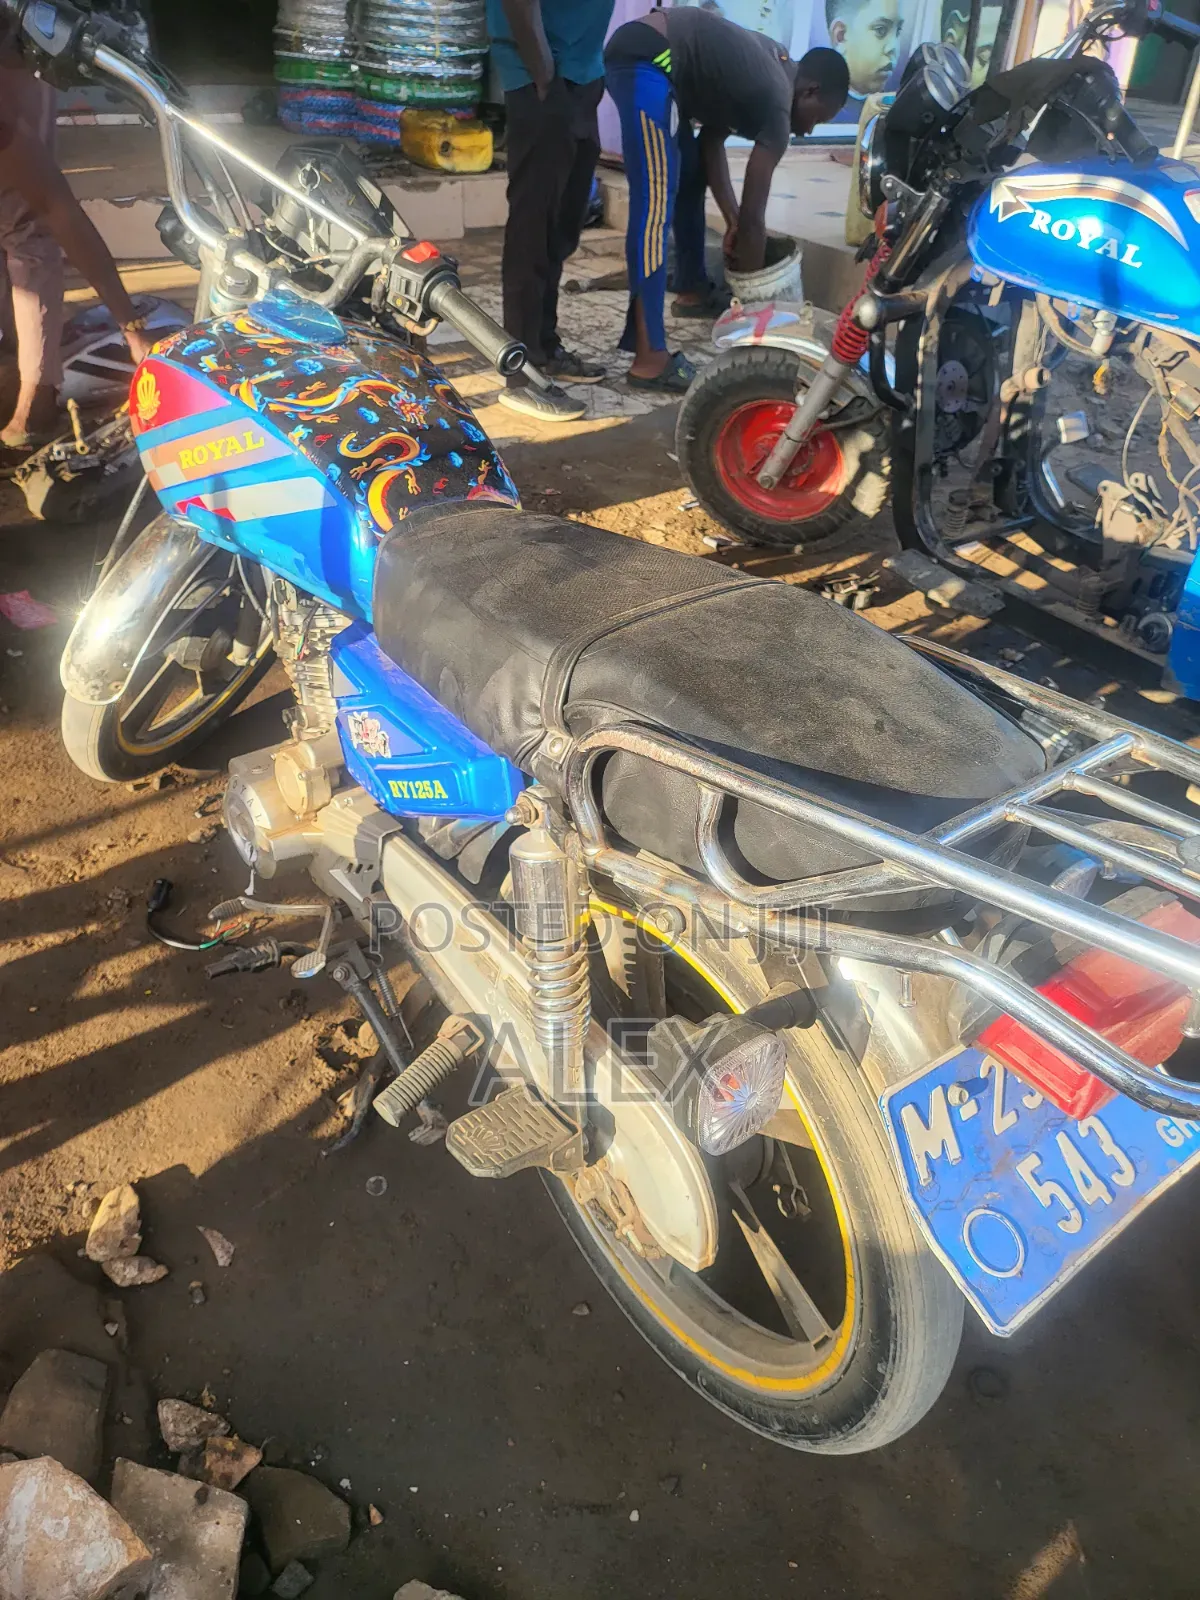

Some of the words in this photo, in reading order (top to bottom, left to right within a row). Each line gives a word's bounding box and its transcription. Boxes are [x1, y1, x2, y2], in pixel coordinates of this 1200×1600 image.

[1028, 209, 1143, 269] ROYAL
[178, 430, 265, 470] ROYAL
[388, 780, 449, 799] RY125A
[1015, 1115, 1137, 1234] 543
